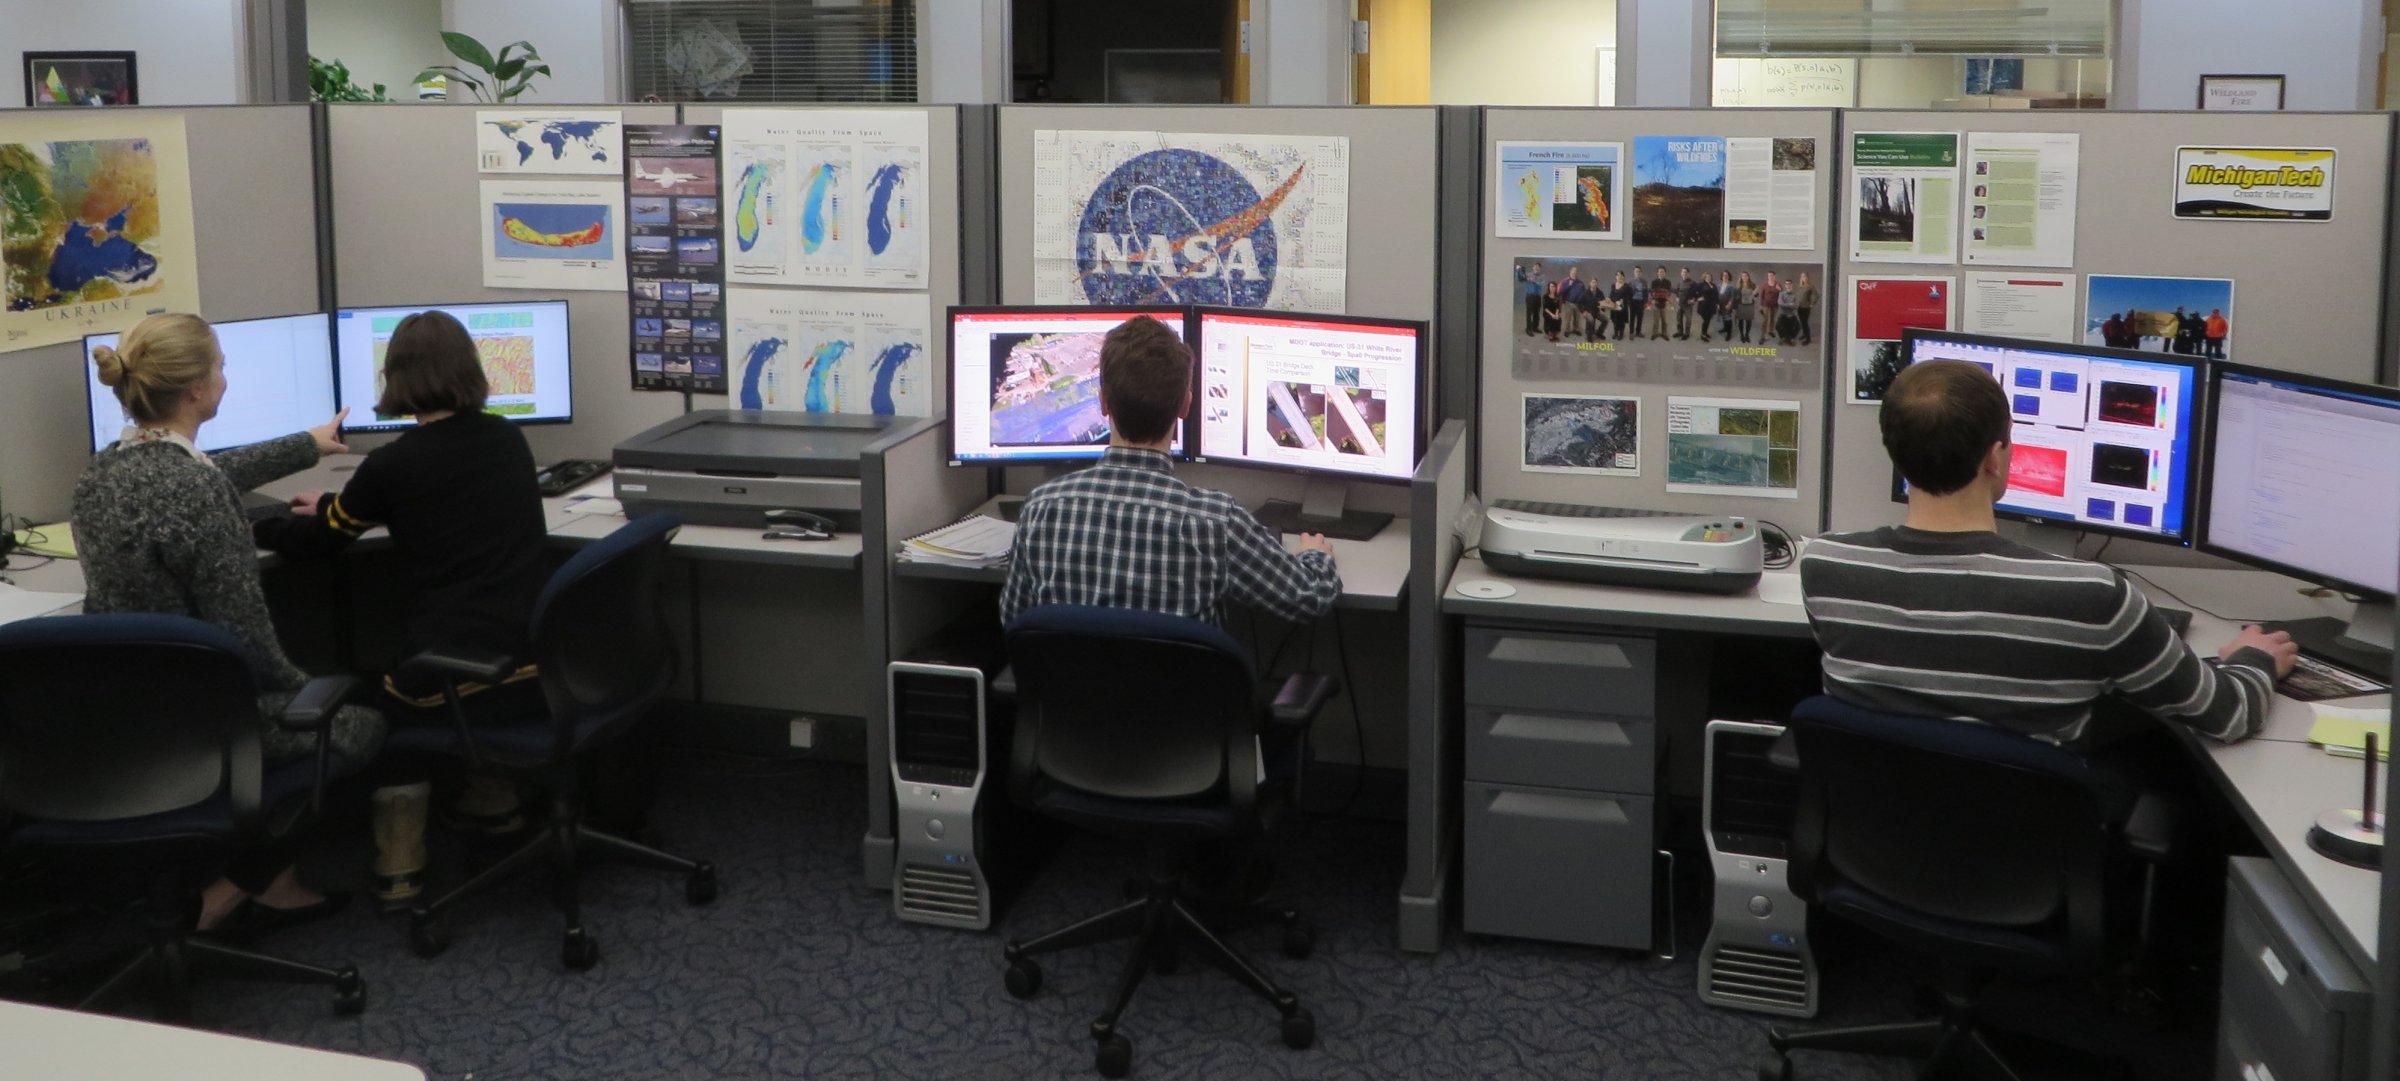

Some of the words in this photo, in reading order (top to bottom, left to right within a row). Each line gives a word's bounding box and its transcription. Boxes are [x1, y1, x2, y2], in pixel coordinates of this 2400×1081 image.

[1668, 141, 1690, 151] RISKS
[1693, 141, 1718, 151] AFTER
[1676, 152, 1718, 162] WILDFIRES
[2233, 189, 2263, 198] Create
[2266, 190, 2280, 198] the
[2282, 190, 2314, 199] Future
[1093, 232, 1267, 281] NASA
[45, 299, 132, 321] UKRAINE
[1576, 342, 1615, 351] MILFOIL
[1729, 346, 1777, 356] WILDFIRE
